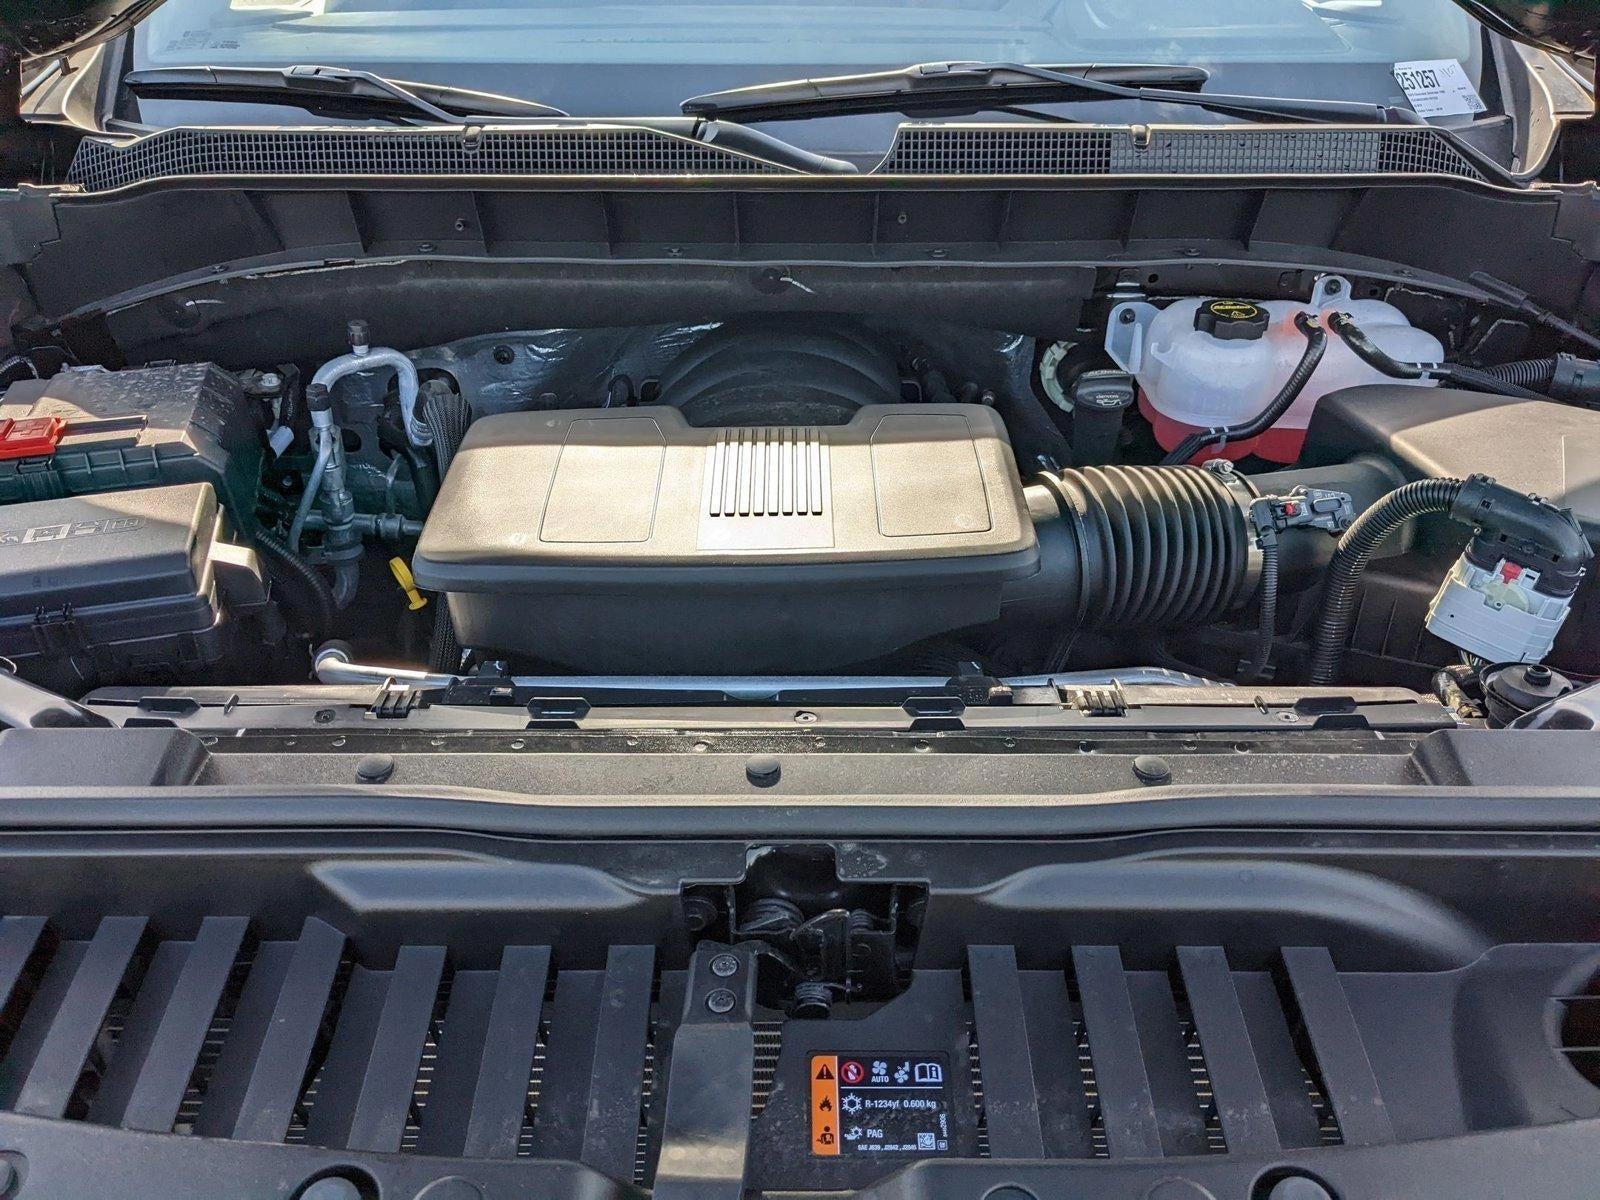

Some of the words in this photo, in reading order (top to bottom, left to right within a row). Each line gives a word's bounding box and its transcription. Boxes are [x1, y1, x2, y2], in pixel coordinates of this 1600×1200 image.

[1396, 69, 1440, 90] 251257
[871, 1075, 890, 1083] AUTO
[865, 1099, 900, 1109] R-1234yf
[903, 1099, 926, 1108] 0.600
[926, 1100, 937, 1109] kg
[866, 1129, 883, 1138] PAG
